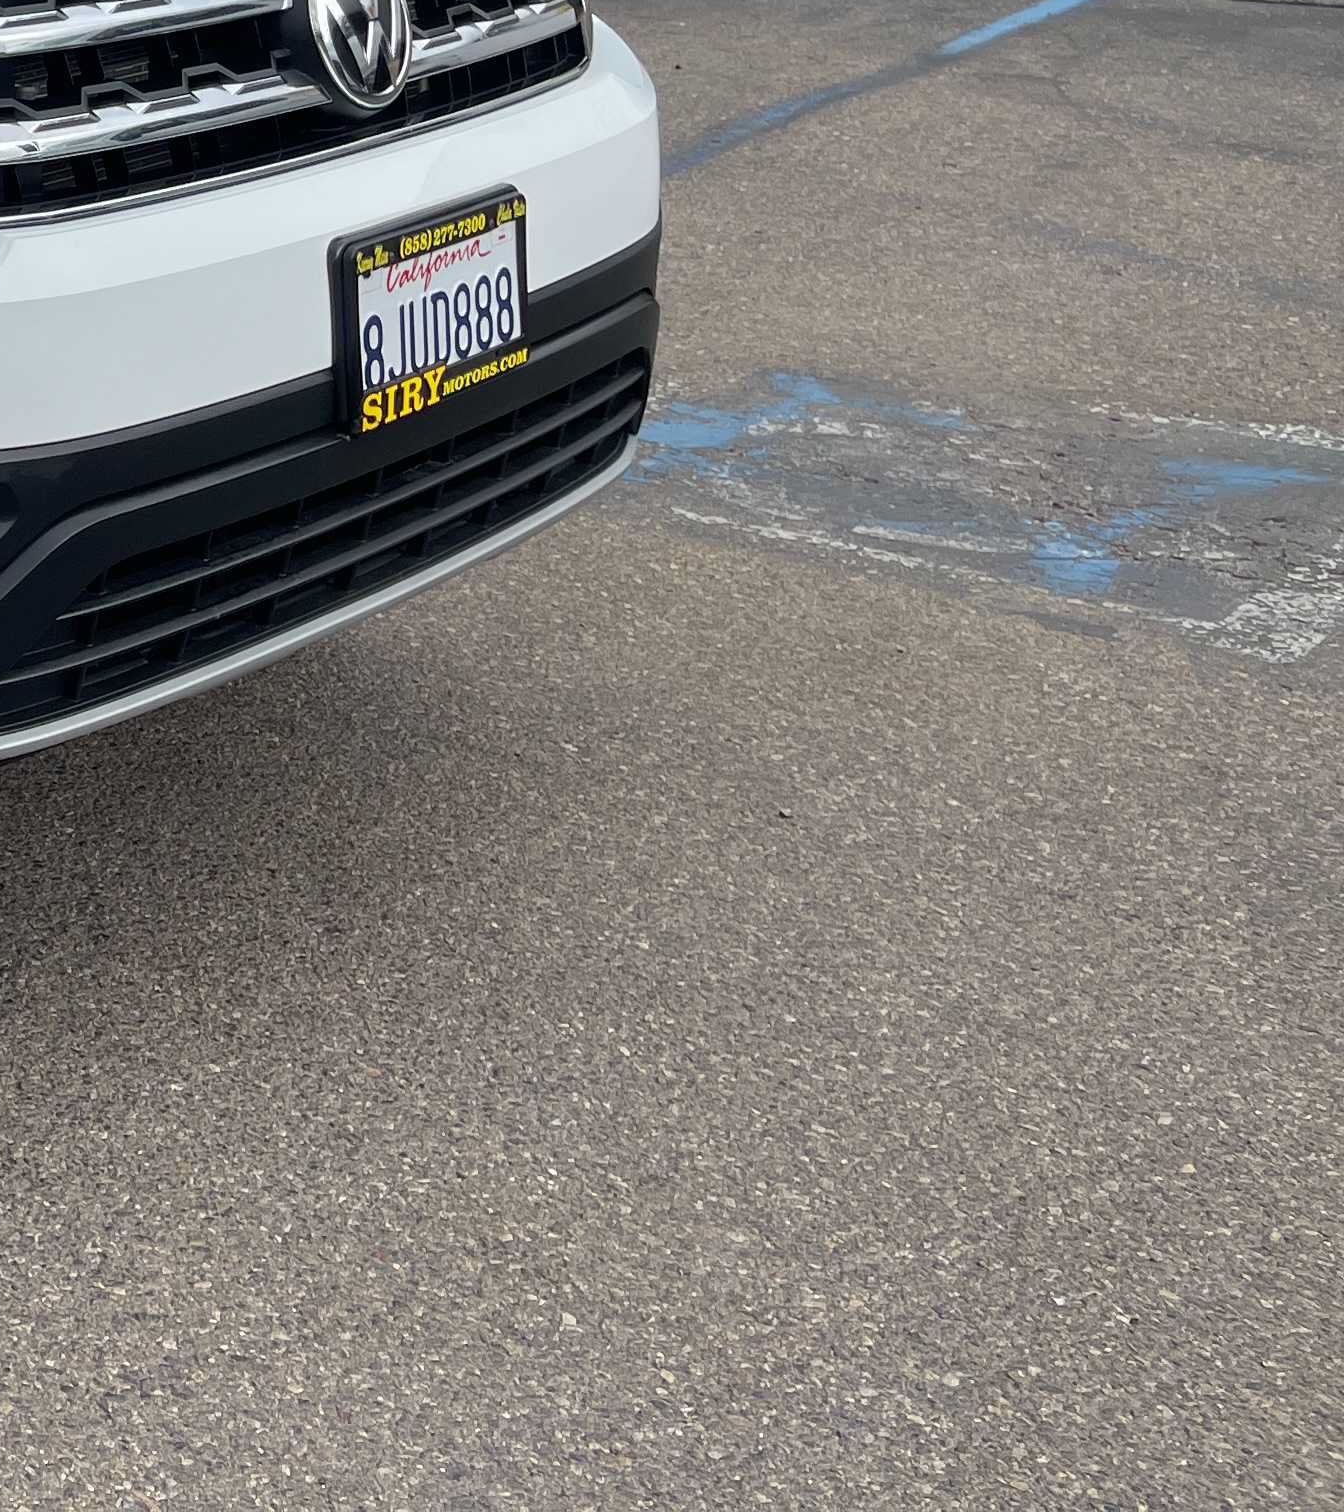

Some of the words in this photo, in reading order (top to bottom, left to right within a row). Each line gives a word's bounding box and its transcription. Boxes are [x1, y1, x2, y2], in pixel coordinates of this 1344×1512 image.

[386, 238, 492, 294] California
[363, 265, 514, 388] 8JUD888
[362, 364, 447, 433] SIRY
[442, 348, 529, 397] MOTORS.COM
